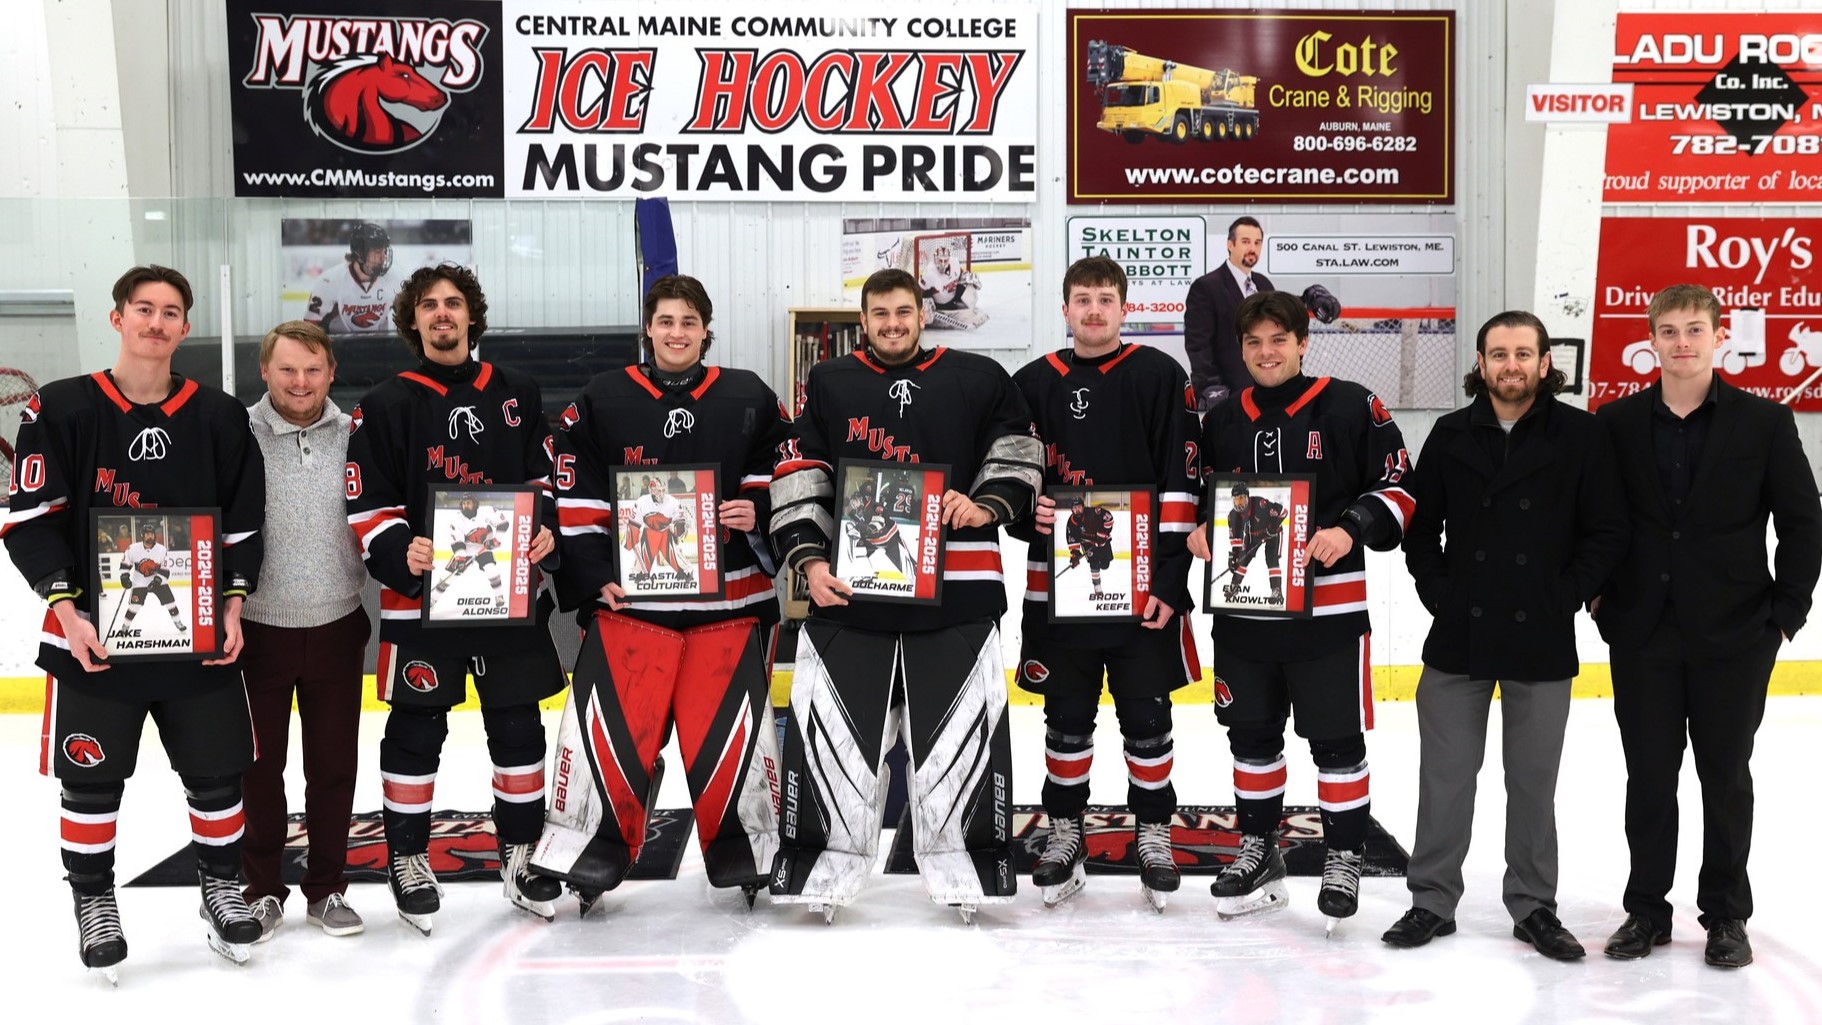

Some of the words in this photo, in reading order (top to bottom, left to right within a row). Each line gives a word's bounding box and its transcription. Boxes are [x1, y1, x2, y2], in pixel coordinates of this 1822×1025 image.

[515, 15, 630, 36] CENTRAL
[638, 16, 721, 36] MAINE
[731, 16, 897, 36] COMMUNITY
[907, 17, 1016, 38] COLLEGE
[247, 15, 485, 88] MUSTANGS
[1294, 30, 1399, 78] Cote
[516, 47, 656, 134] ICE
[679, 48, 1025, 135] HOCKEY
[1715, 74, 1746, 89] Co.
[1752, 74, 1788, 89] Inc.
[1268, 84, 1330, 108] Crane
[1336, 86, 1351, 108] &
[1357, 86, 1432, 114] Rigging
[1532, 94, 1624, 113] VISITOR
[1639, 103, 1801, 124] LEWISTON,
[1319, 122, 1361, 133] AUBURN,
[1362, 122, 1391, 132] MAINE
[1293, 136, 1417, 152] 800-696-6282
[1670, 135, 1822, 155] 782-708
[522, 143, 847, 192] MUSTANG
[862, 144, 1035, 192] PRIDE
[1125, 164, 1399, 185] www.cotecrane.com
[243, 168, 495, 191] www.CMMustangs.com
[1602, 171, 1651, 190] roud
[1657, 174, 1750, 194] supporter
[1758, 170, 1782, 190] of
[1081, 227, 1191, 242] SKELTON
[1081, 246, 1191, 259] TAINTOR
[1276, 243, 1298, 251] 500
[1302, 243, 1338, 251] CANAL
[1343, 243, 1361, 251] ST.
[1365, 243, 1421, 252] LEWISTON,
[1425, 243, 1444, 251] ME.
[1685, 225, 1813, 284] Roy's
[1126, 265, 1192, 276] BBOTT
[1316, 258, 1399, 267] STA.LAW.COM
[376, 289, 384, 301] C
[1605, 286, 1653, 306] Driv
[1712, 286, 1772, 307] Rider
[502, 399, 521, 427] C
[1307, 431, 1323, 459] A
[8, 453, 46, 495] 10
[701, 493, 717, 571] 2024-2025
[922, 494, 941, 575] 2024-2025
[514, 515, 532, 595] 2024-2025
[1135, 514, 1150, 592] 2024-2025
[1291, 504, 1308, 588] 2024-2025
[197, 540, 213, 626] 2024-2025
[636, 581, 698, 591] COUTURIER
[1222, 585, 1251, 594] EVAN
[457, 597, 491, 606] DIEGO
[1089, 593, 1126, 601] BRODY
[1096, 602, 1131, 611] KEEFE
[462, 607, 509, 616] ALONSO
[108, 629, 142, 639] JAKE
[116, 639, 191, 650] HARSHMAN
[555, 746, 573, 812] BAUER
[785, 770, 799, 840] BAUER
[994, 772, 1006, 842] BAUER
